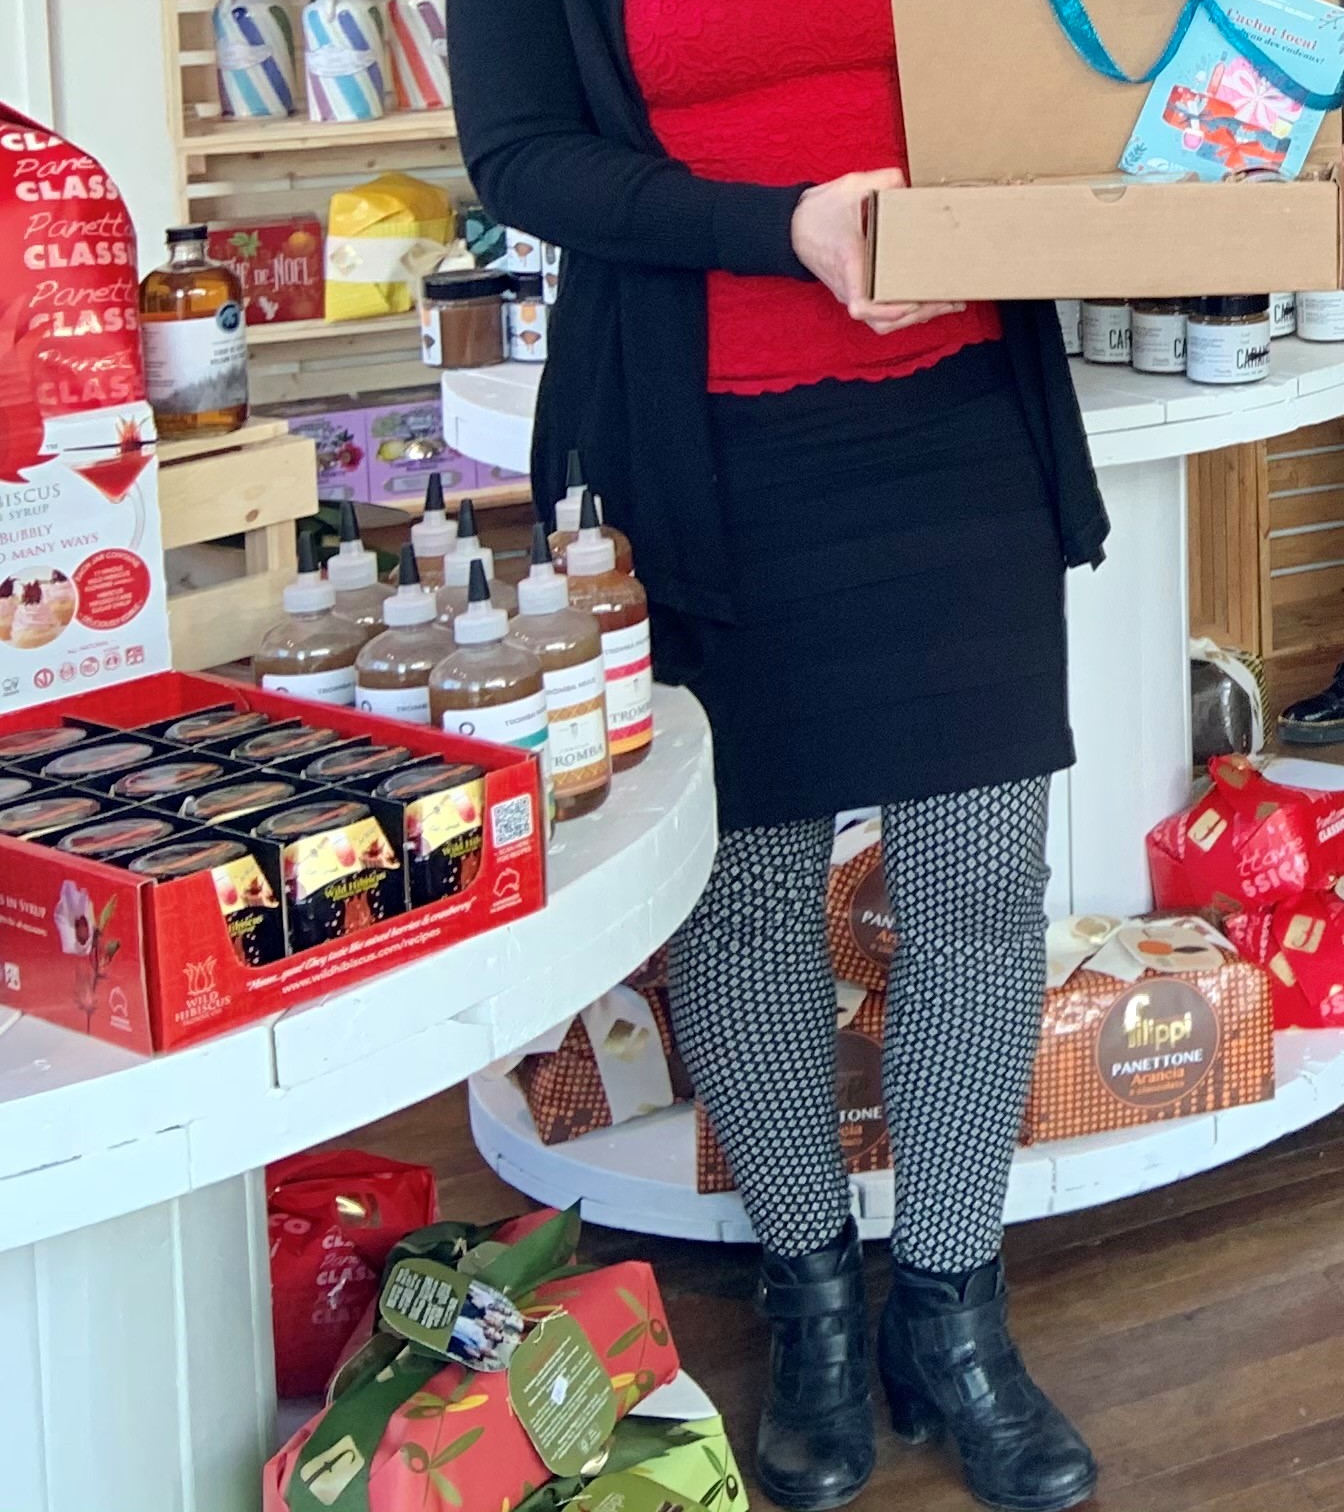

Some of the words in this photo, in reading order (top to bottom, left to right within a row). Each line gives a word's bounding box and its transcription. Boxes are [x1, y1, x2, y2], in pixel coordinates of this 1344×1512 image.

[9, 503, 50, 521] SYRUP
[12, 542, 56, 561] MANY
[60, 532, 99, 550] WAYS
[281, 926, 442, 995] www.wildhibiscus.com/recipes
[174, 995, 232, 1023] HIBISCUS
[186, 991, 219, 1009] WILD
[1111, 1047, 1204, 1078] PANETTONE
[1130, 1067, 1186, 1086] Arancia
